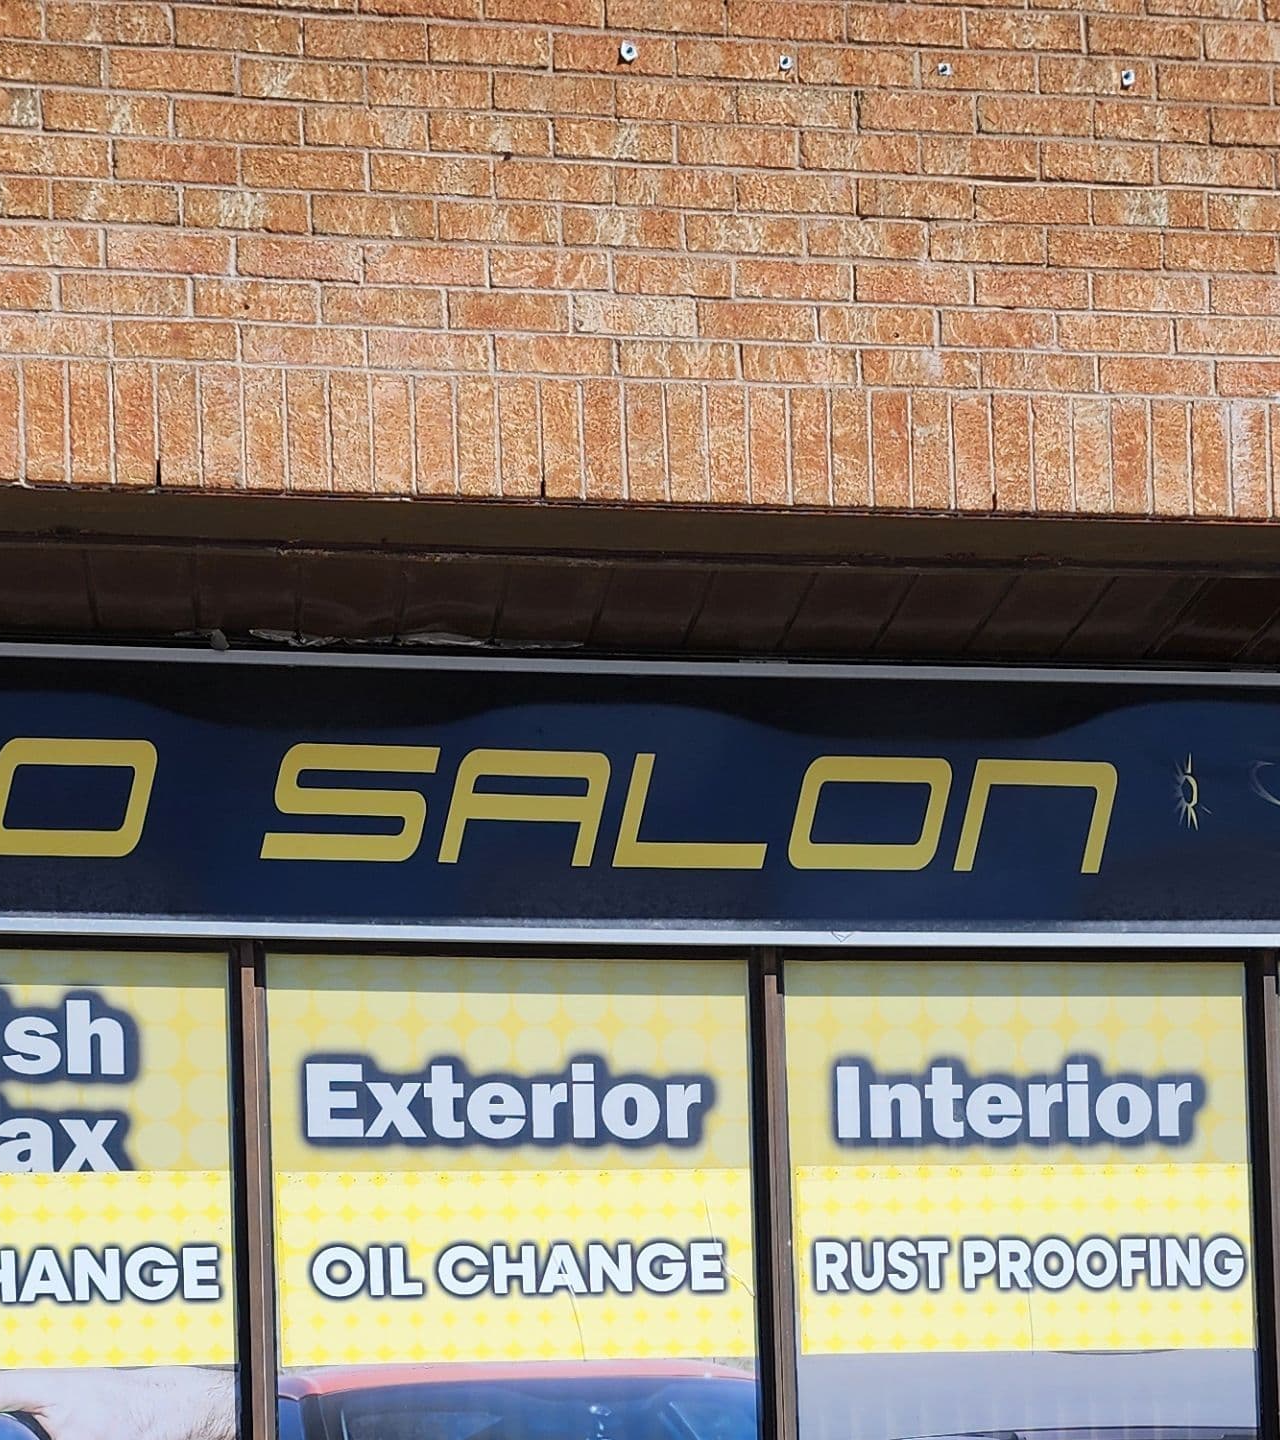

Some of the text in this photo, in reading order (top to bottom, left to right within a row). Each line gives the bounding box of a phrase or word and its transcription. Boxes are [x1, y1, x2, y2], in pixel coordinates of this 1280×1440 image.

[259, 742, 1119, 875] SALON
[305, 1061, 702, 1141] Exterior
[835, 1063, 1193, 1140] Interior
[310, 1241, 725, 1298] OIL CHANGE
[815, 1235, 1245, 1292] RUST PROOFING
